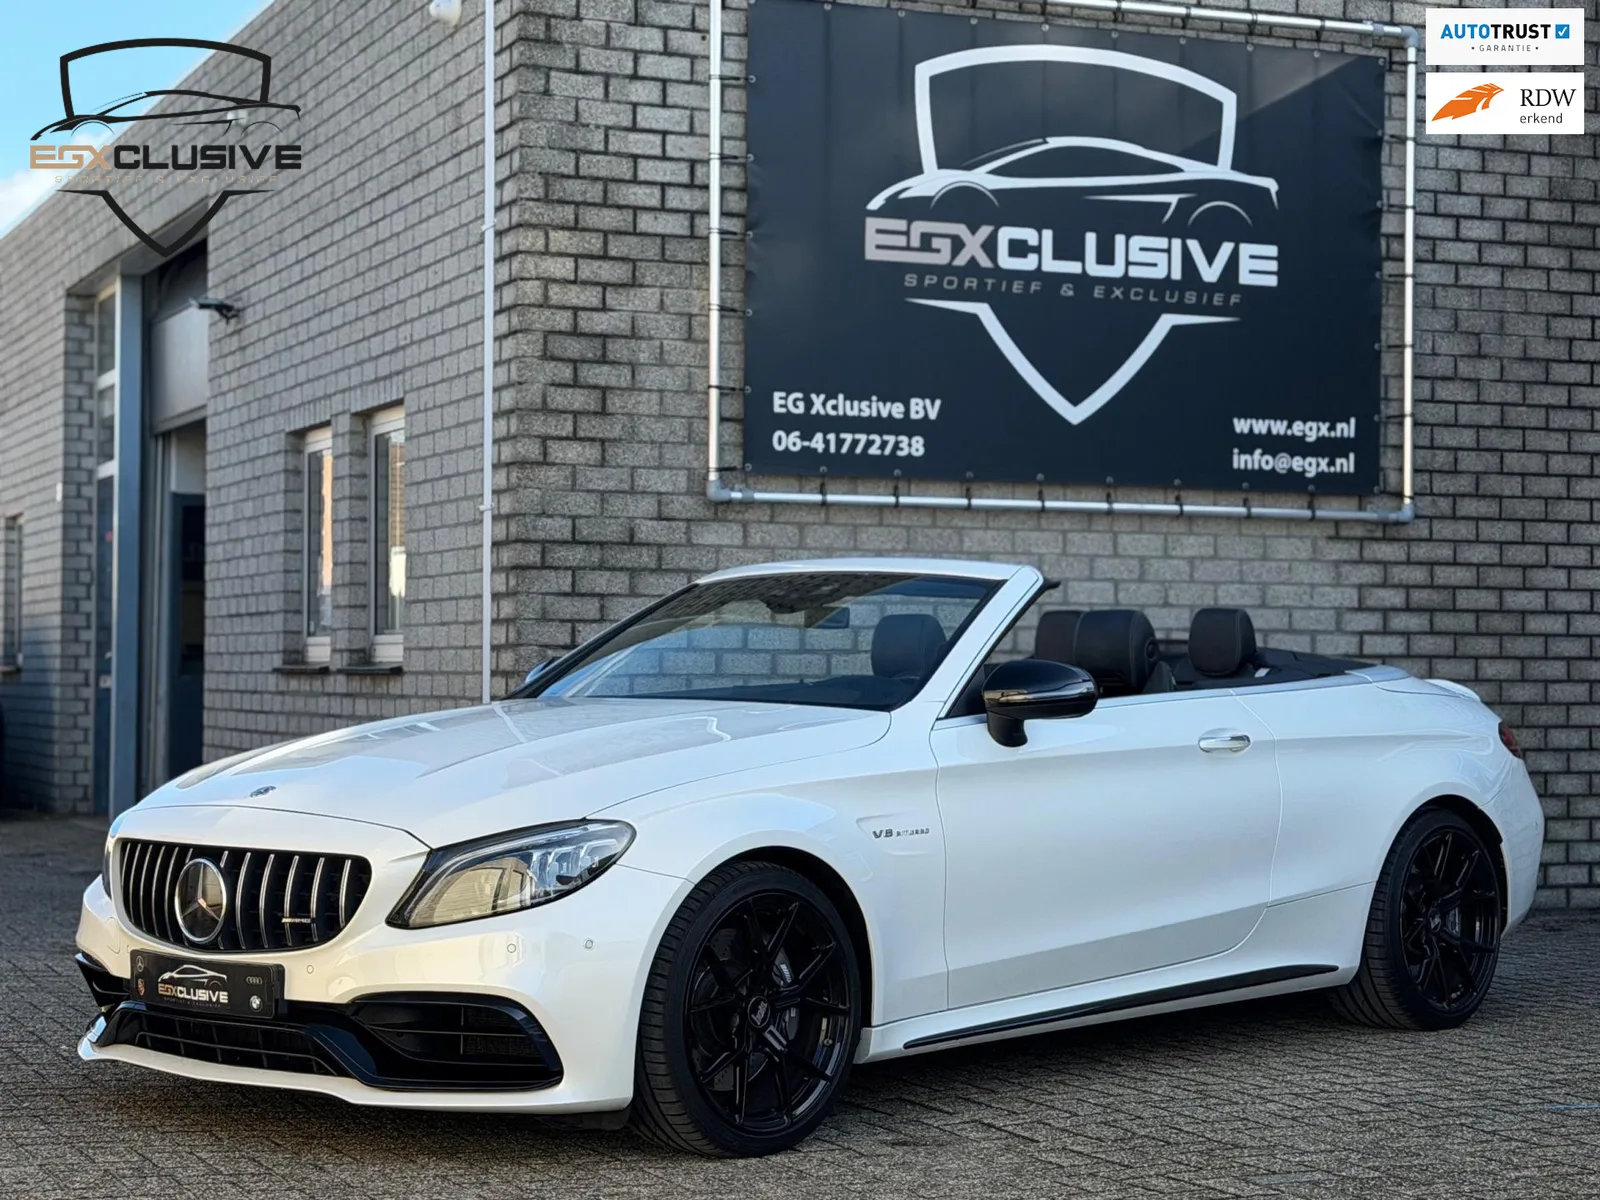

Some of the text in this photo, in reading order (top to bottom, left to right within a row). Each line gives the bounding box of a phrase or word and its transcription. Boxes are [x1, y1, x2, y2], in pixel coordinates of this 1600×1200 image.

[864, 217, 1279, 287] EGXCLUSIVE
[904, 273, 1243, 306] SPORTIEF & EXCLUSIEF
[772, 391, 942, 420] EG Xclusive BV
[772, 430, 926, 457] 06-41772738
[1232, 416, 1356, 443] www.egx.nl
[1232, 448, 1355, 478] info@egx.nl
